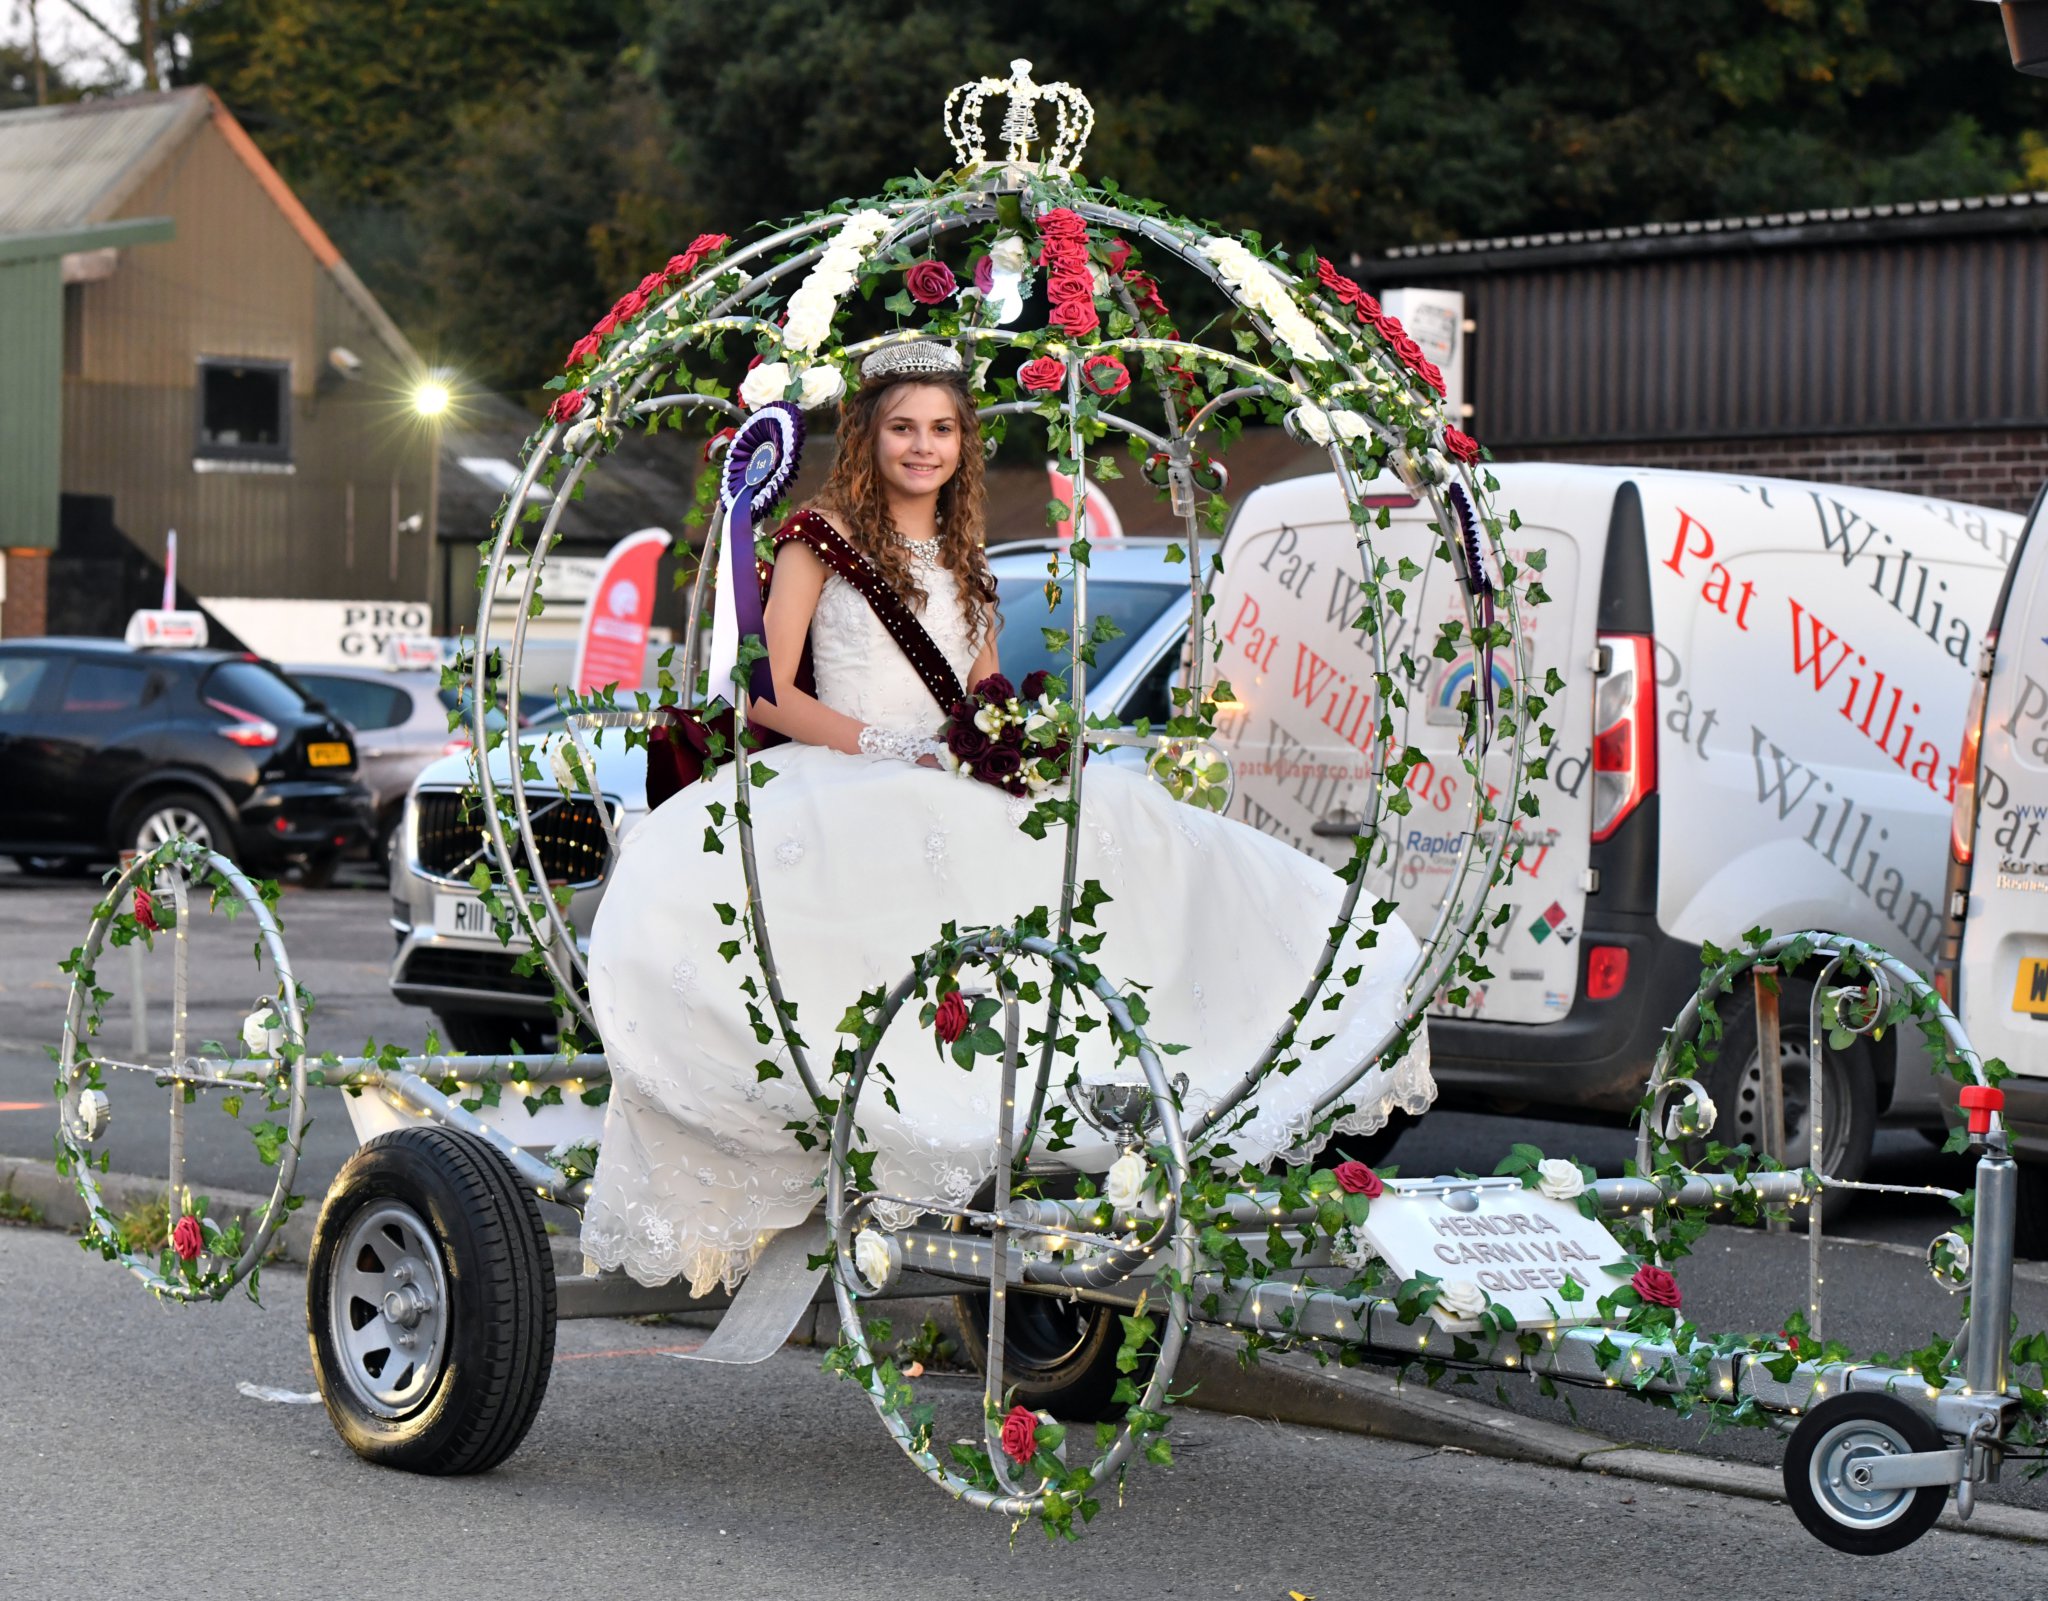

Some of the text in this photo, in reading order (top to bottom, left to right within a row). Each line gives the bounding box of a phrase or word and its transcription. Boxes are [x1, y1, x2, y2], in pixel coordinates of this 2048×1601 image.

[1260, 522, 1317, 600] Pat
[1661, 506, 1757, 632] Pat
[1808, 490, 1984, 676] Willia
[345, 608, 424, 629] PRO
[1224, 593, 1280, 674] Pat
[1292, 642, 1459, 813] Willims
[1977, 764, 2041, 859] Pat
[1407, 831, 1463, 857] Rapid
[1428, 1213, 1561, 1237] HENDRA
[1433, 1239, 1600, 1265] CARNIVAL
[1476, 1266, 1591, 1292] QUEEN
